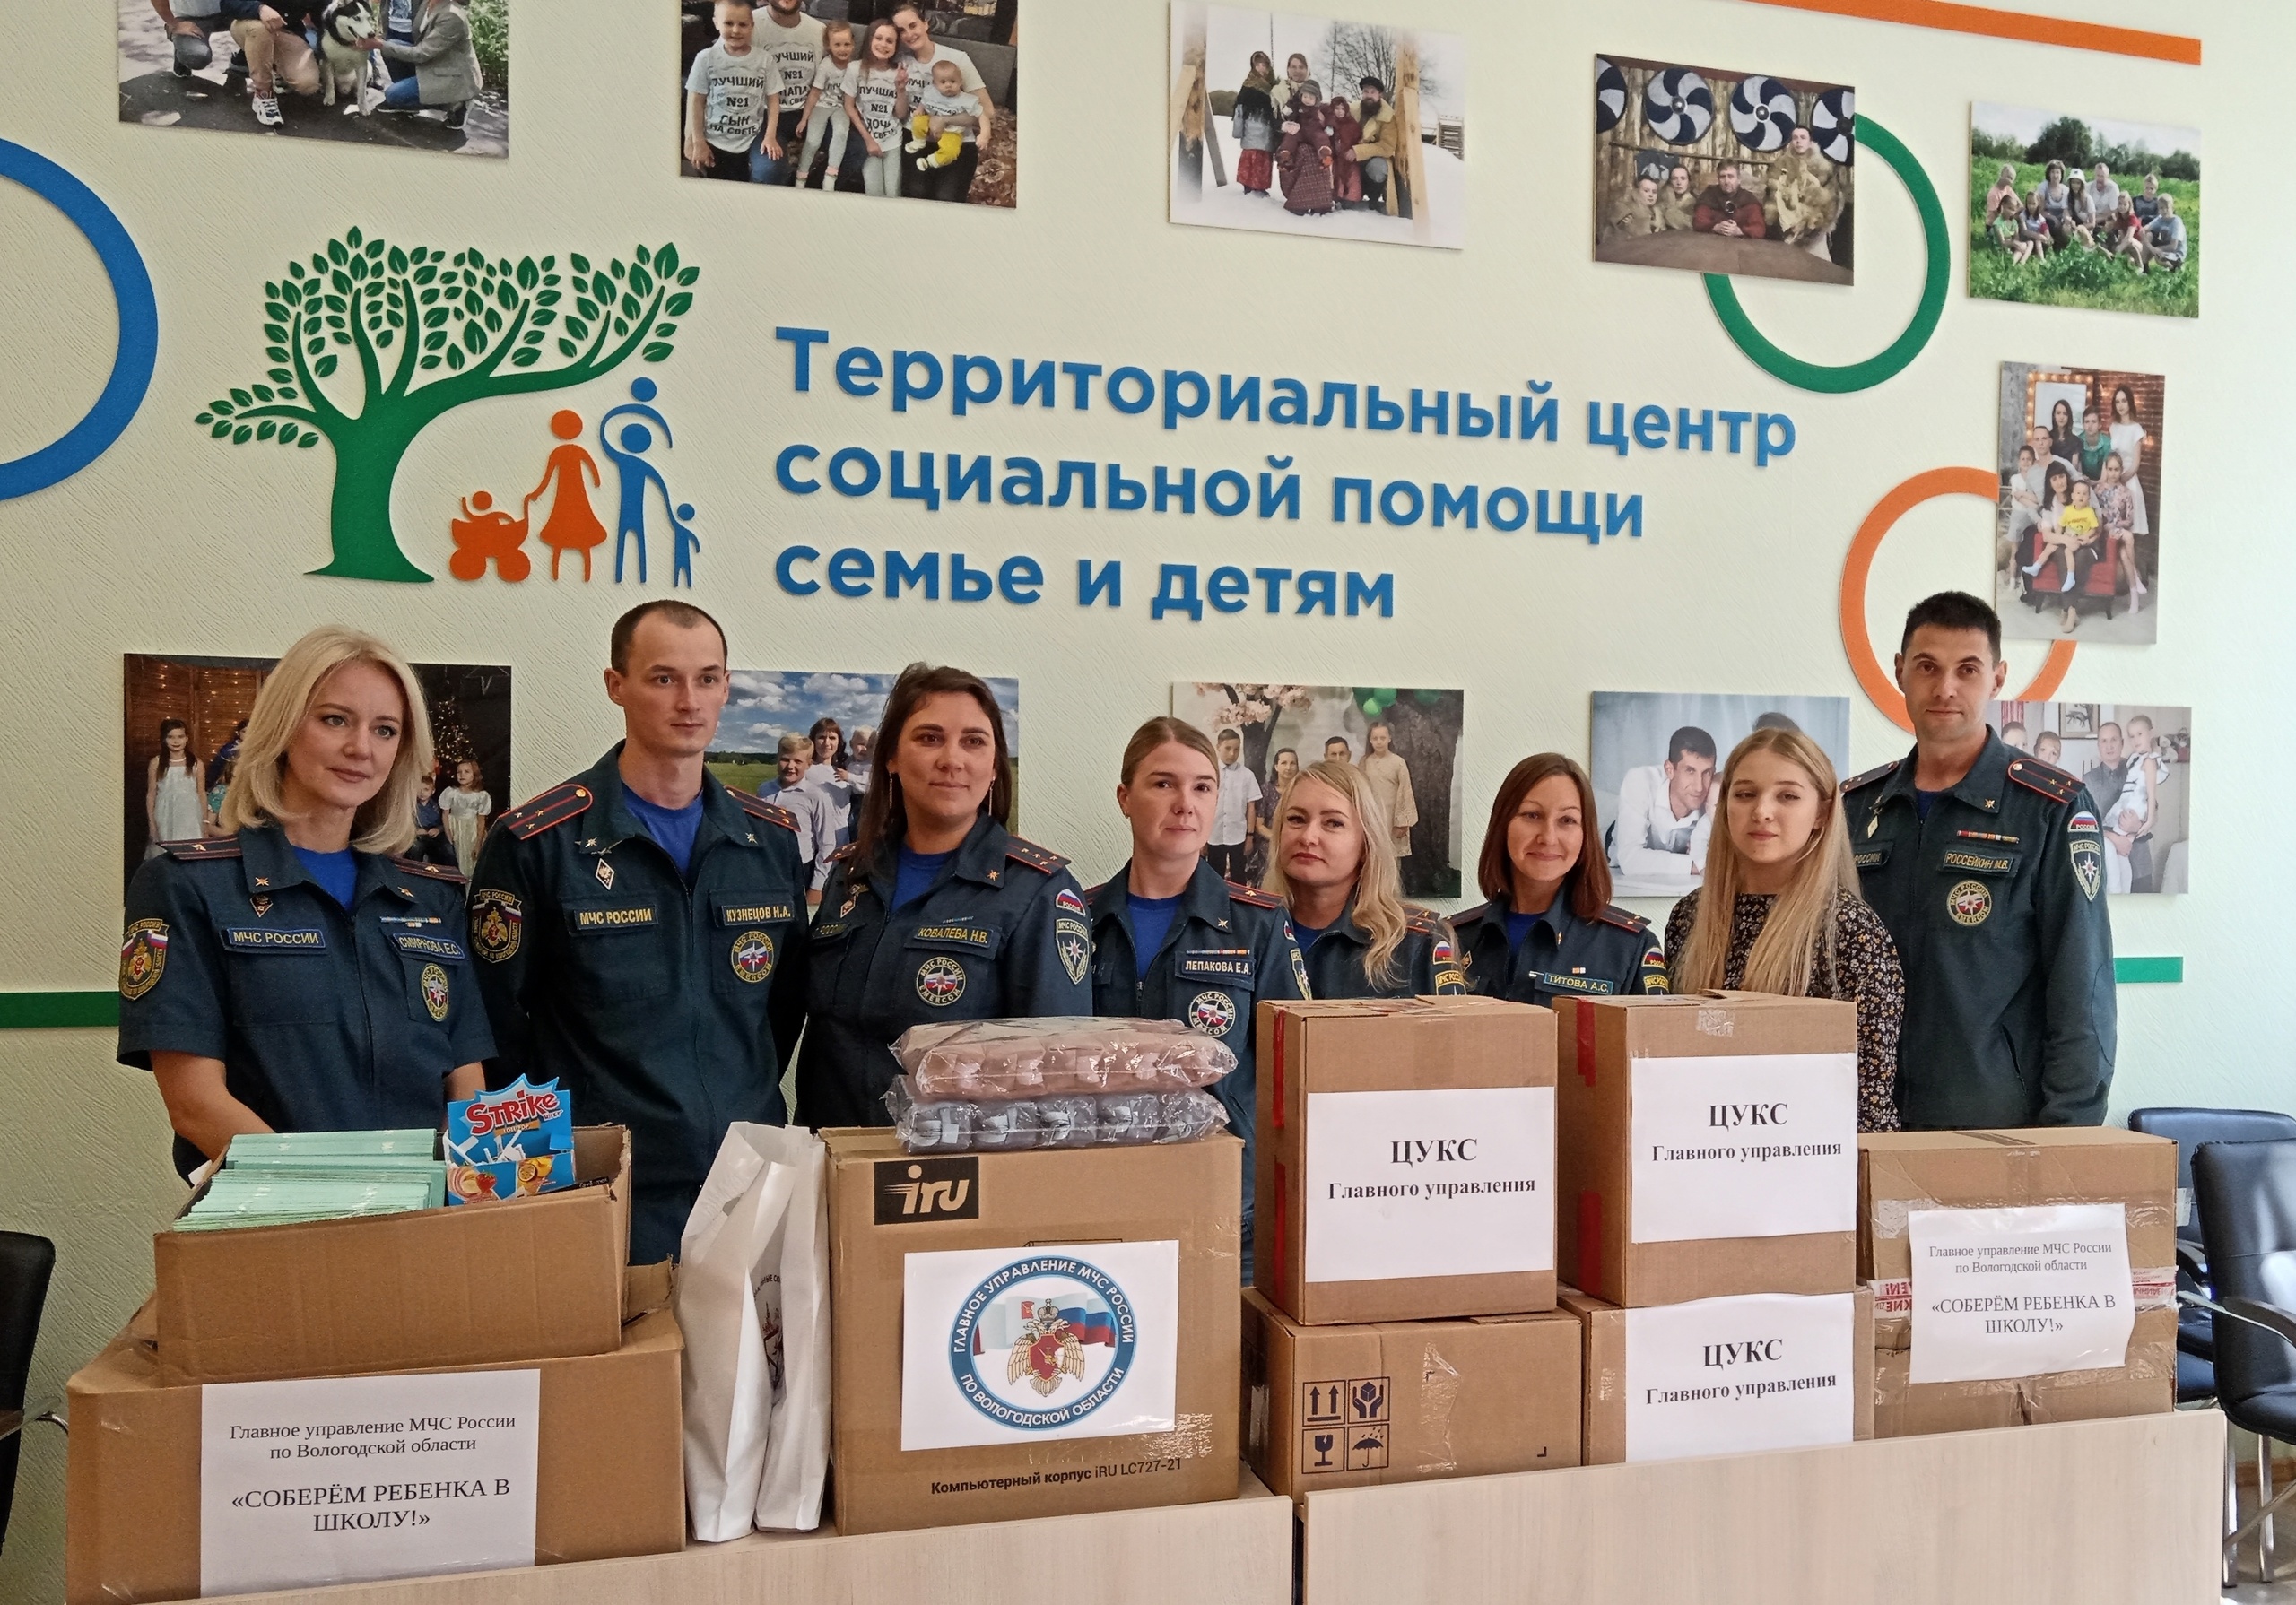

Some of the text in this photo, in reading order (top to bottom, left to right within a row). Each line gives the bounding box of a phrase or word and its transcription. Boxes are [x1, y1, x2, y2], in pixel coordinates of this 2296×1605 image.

[726, 97, 749, 107] №1
[775, 326, 1796, 467] Территориальный центр
[775, 444, 1643, 545] социальной помощи
[775, 544, 1394, 621] семье и детям
[1946, 853, 1993, 869] РОССЕЙКИН
[579, 908, 652, 925] МЧС РОССИИ
[726, 905, 791, 923] КУЗНЕЦОВ Н.А.
[233, 930, 320, 945] МЧС РОССИИ
[398, 936, 445, 954] СМИРНОВА
[918, 927, 987, 944] КОВАЛЕВА Н.В.
[920, 959, 964, 981] МЧС РОССИИ
[1185, 960, 1252, 976] ЛЕПАКОВА Е.А.
[919, 985, 961, 1004] EMERCOM
[1548, 975, 1609, 993] ТИТОВА А.С.
[1196, 993, 1233, 1020] МЧС РОССИИ
[1708, 1102, 1788, 1132] ЦУКС
[1390, 1138, 1478, 1168] ЦУКС
[1652, 1143, 1841, 1162] Главного управления
[1328, 1179, 1535, 1201] Главного управления
[1929, 1242, 2112, 1259] Главное управление МЧС России
[1955, 1259, 2088, 1275] по Вологодской области
[953, 1259, 1135, 1353] ГЛАВНОЕ УПРАВЛЕНИЕ МЧС РОССИИ
[1931, 1294, 2116, 1314] «СОБЕРЁМ РЕБЕНКА В
[1985, 1318, 2064, 1334] ШКОЛУ!»
[1703, 1339, 1783, 1371] ЦУКС
[960, 1366, 1125, 1427] ПО ВОЛОГОДСКОЙ ОБЛАСТИ
[1646, 1375, 1837, 1405] Главного управления
[230, 1415, 517, 1442] Главное управление МЧС России
[270, 1437, 476, 1460] по Вологодской области
[931, 1458, 1182, 1495] Компьютерный корпус iRU LC727-21
[231, 1479, 510, 1509] «СОБЕРЁМ РЕБЕНКА В
[313, 1509, 430, 1531] ШКОЛУ!»
